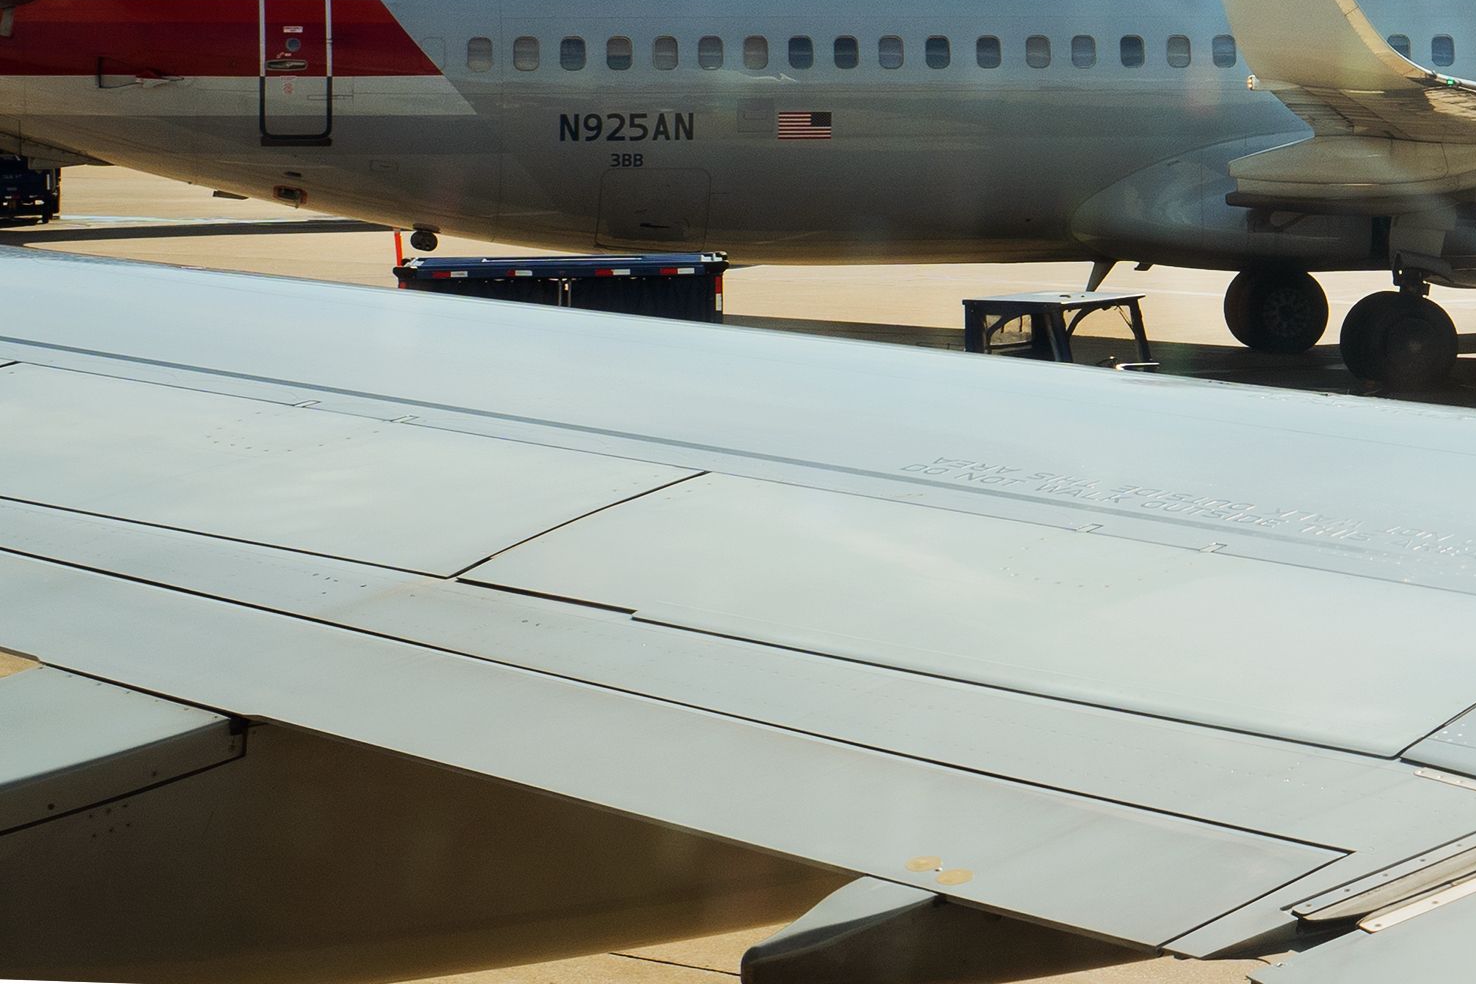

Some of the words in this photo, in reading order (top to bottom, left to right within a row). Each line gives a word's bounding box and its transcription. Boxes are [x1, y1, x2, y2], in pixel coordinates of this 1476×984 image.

[559, 112, 694, 142] N925AN
[610, 153, 644, 168] 3BB
[931, 456, 1023, 474] AREA
[899, 463, 949, 475] DO
[954, 471, 1026, 487] NOT
[1033, 483, 1132, 504] WALK
[1140, 501, 1286, 529] OUTSIDE
